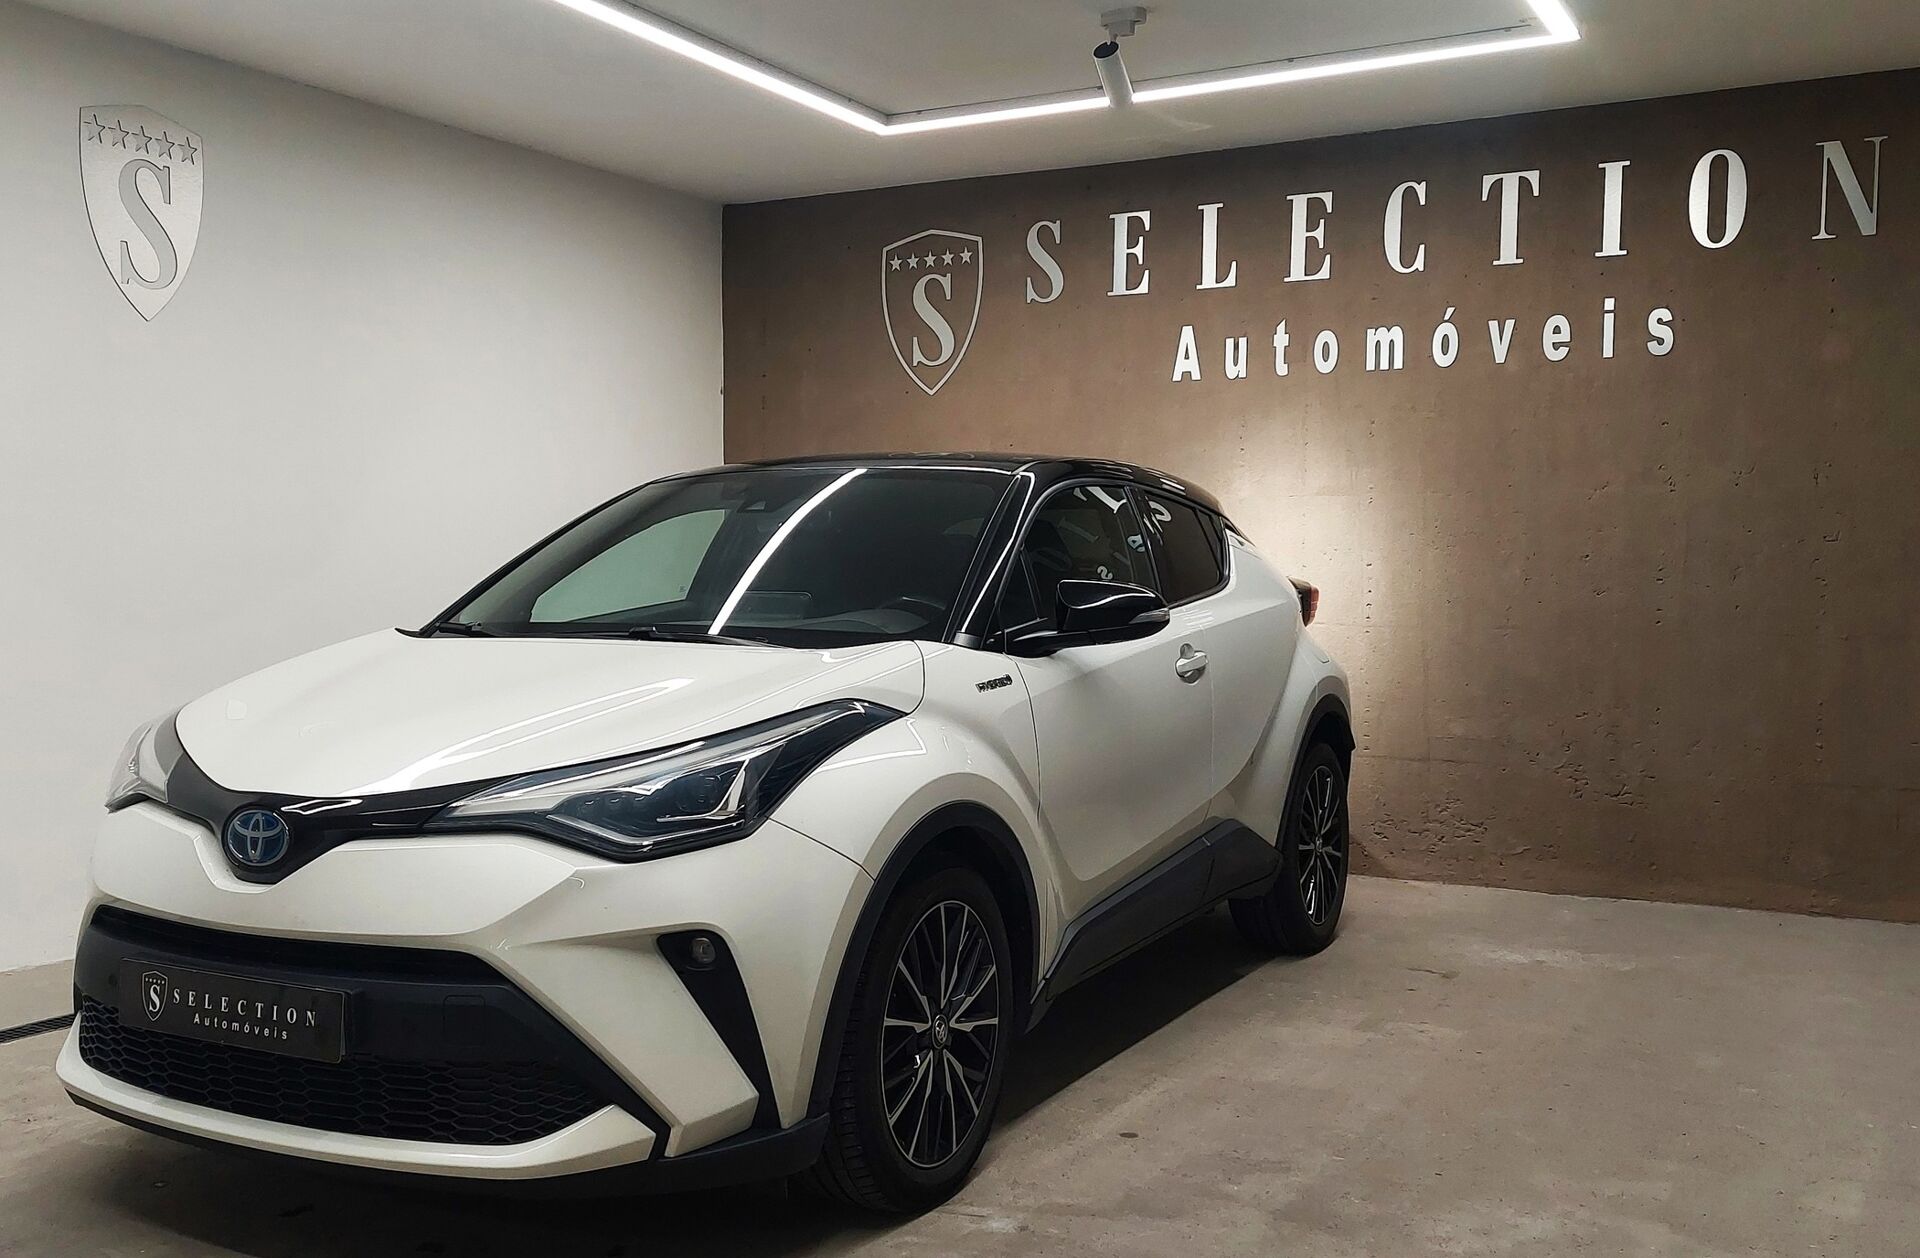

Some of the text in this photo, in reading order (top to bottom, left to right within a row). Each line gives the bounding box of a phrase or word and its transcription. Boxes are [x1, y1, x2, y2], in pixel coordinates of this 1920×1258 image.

[118, 158, 178, 290] S
[1025, 135, 1888, 305] SELECTION
[911, 272, 956, 368] S
[1171, 297, 1676, 383] Automóveis
[173, 988, 317, 1027] SELECTION
[193, 1013, 288, 1040] Automóveis
